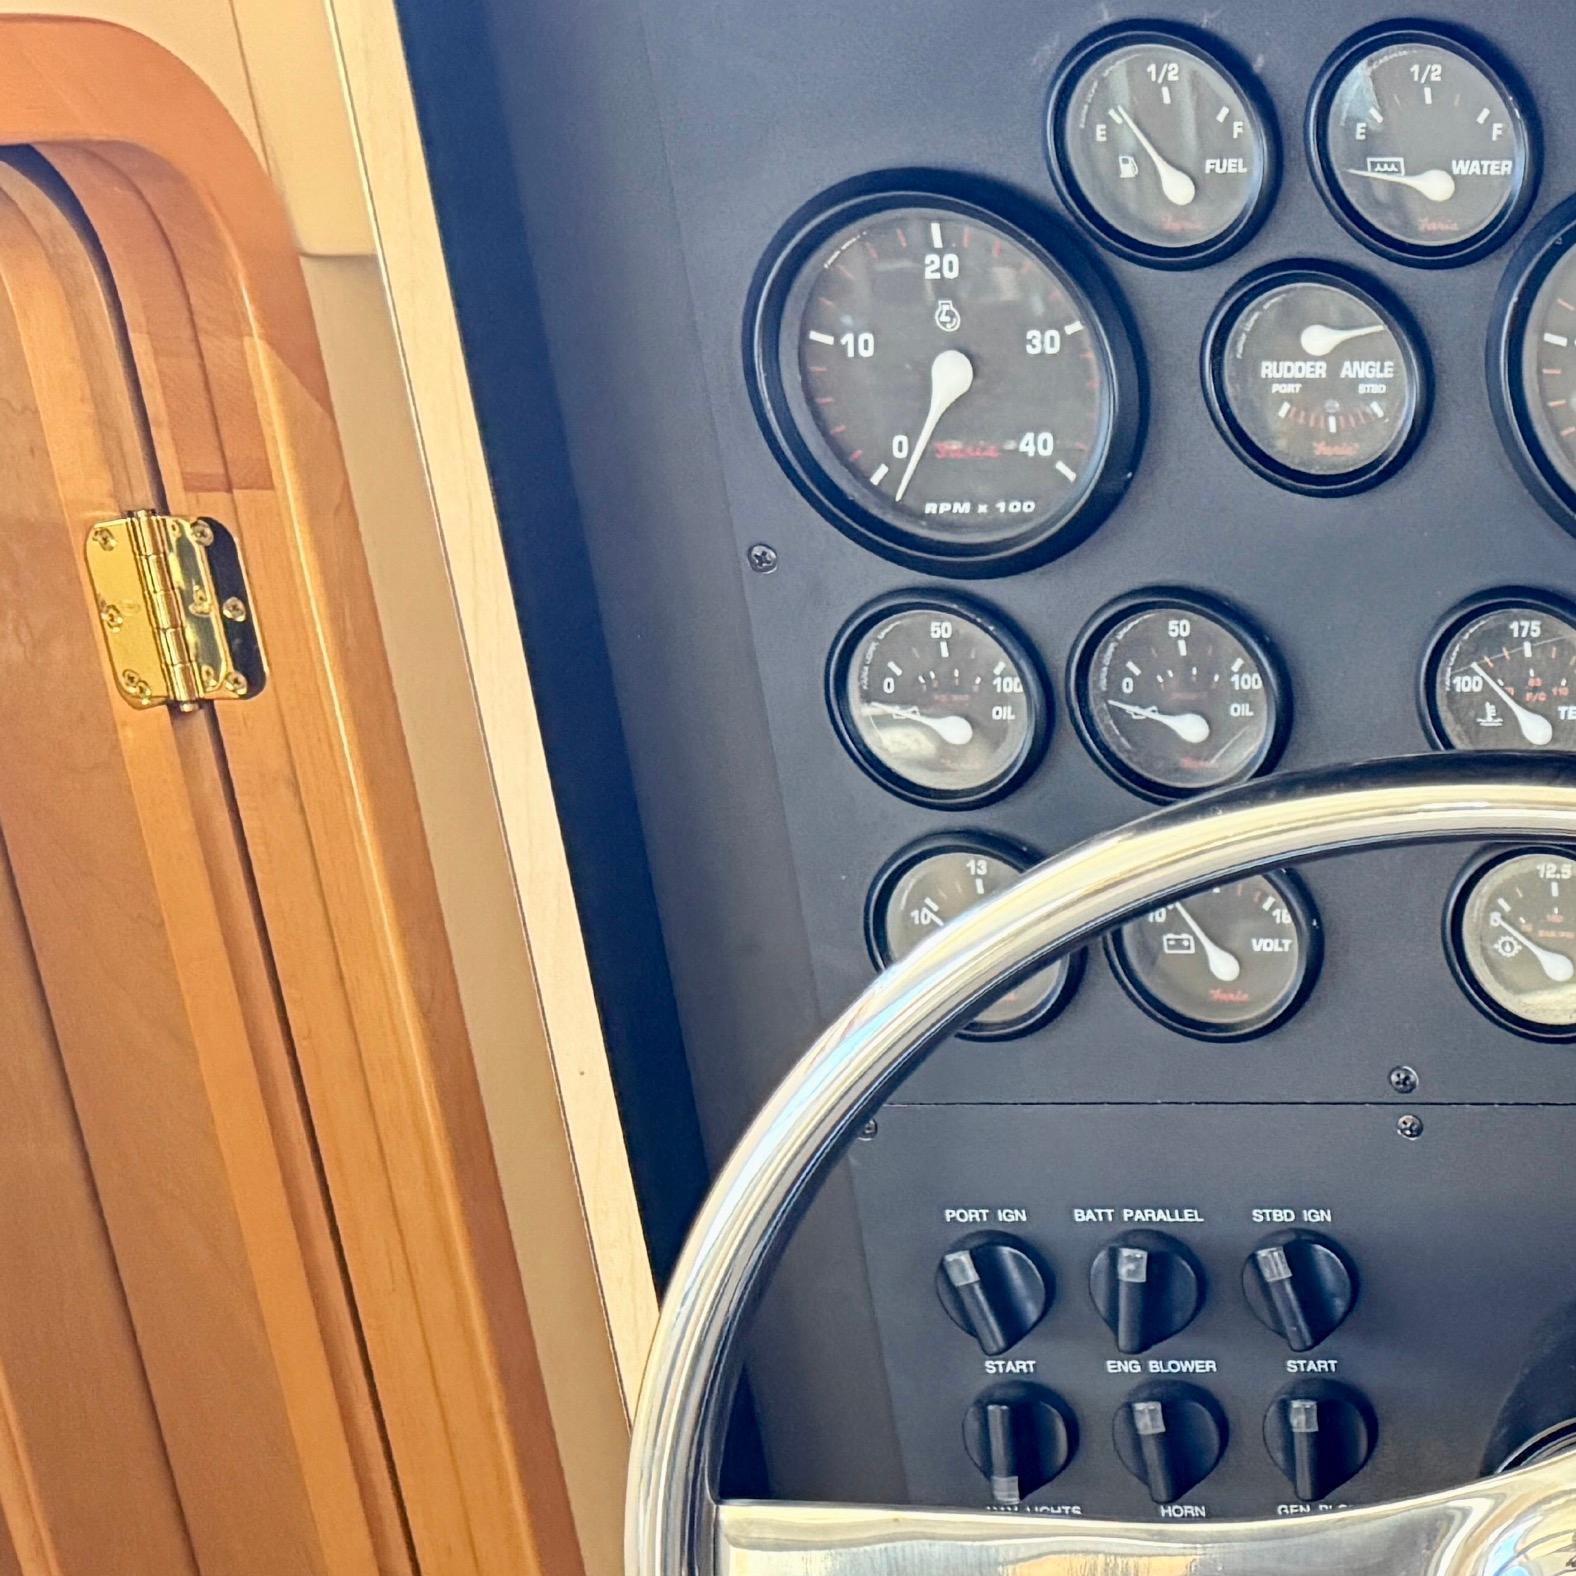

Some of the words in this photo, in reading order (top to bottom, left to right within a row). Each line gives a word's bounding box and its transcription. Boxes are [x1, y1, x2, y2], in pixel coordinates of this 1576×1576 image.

[1147, 63, 1179, 83] 1/2
[1410, 64, 1441, 83] 1/2
[1096, 124, 1106, 141] E
[1233, 121, 1243, 138] F
[1356, 122, 1366, 139] E
[1492, 123, 1503, 141] F
[1205, 158, 1247, 173] FUEL
[1452, 160, 1512, 175] WATER
[925, 254, 959, 279] 20
[840, 332, 874, 357] 10
[1026, 330, 1060, 354] 30
[1261, 361, 1327, 378] RUDDER
[1340, 361, 1394, 378] ANGLE
[1272, 384, 1302, 393] PORT
[1358, 384, 1386, 394] STBD
[893, 435, 908, 458] 0
[1019, 432, 1053, 456] 40
[925, 502, 970, 514] RPM
[996, 501, 1035, 513] 100
[1168, 620, 1190, 637] 50
[1231, 673, 1262, 690] 100
[1454, 677, 1482, 692] 100
[1230, 703, 1254, 717] OIL
[1252, 939, 1292, 951] VOLT
[945, 1209, 989, 1222] PORT
[998, 1209, 1026, 1222] IGN
[1074, 1209, 1114, 1221] BATT
[1123, 1209, 1204, 1221] PARALLEL
[1252, 1209, 1295, 1222] STBD
[1303, 1209, 1331, 1222] IGN
[985, 1361, 1036, 1373] START
[1106, 1360, 1141, 1373] ENG
[1148, 1360, 1216, 1372] BLOWER
[1287, 1360, 1337, 1372] START
[1160, 1505, 1205, 1517] HORN
